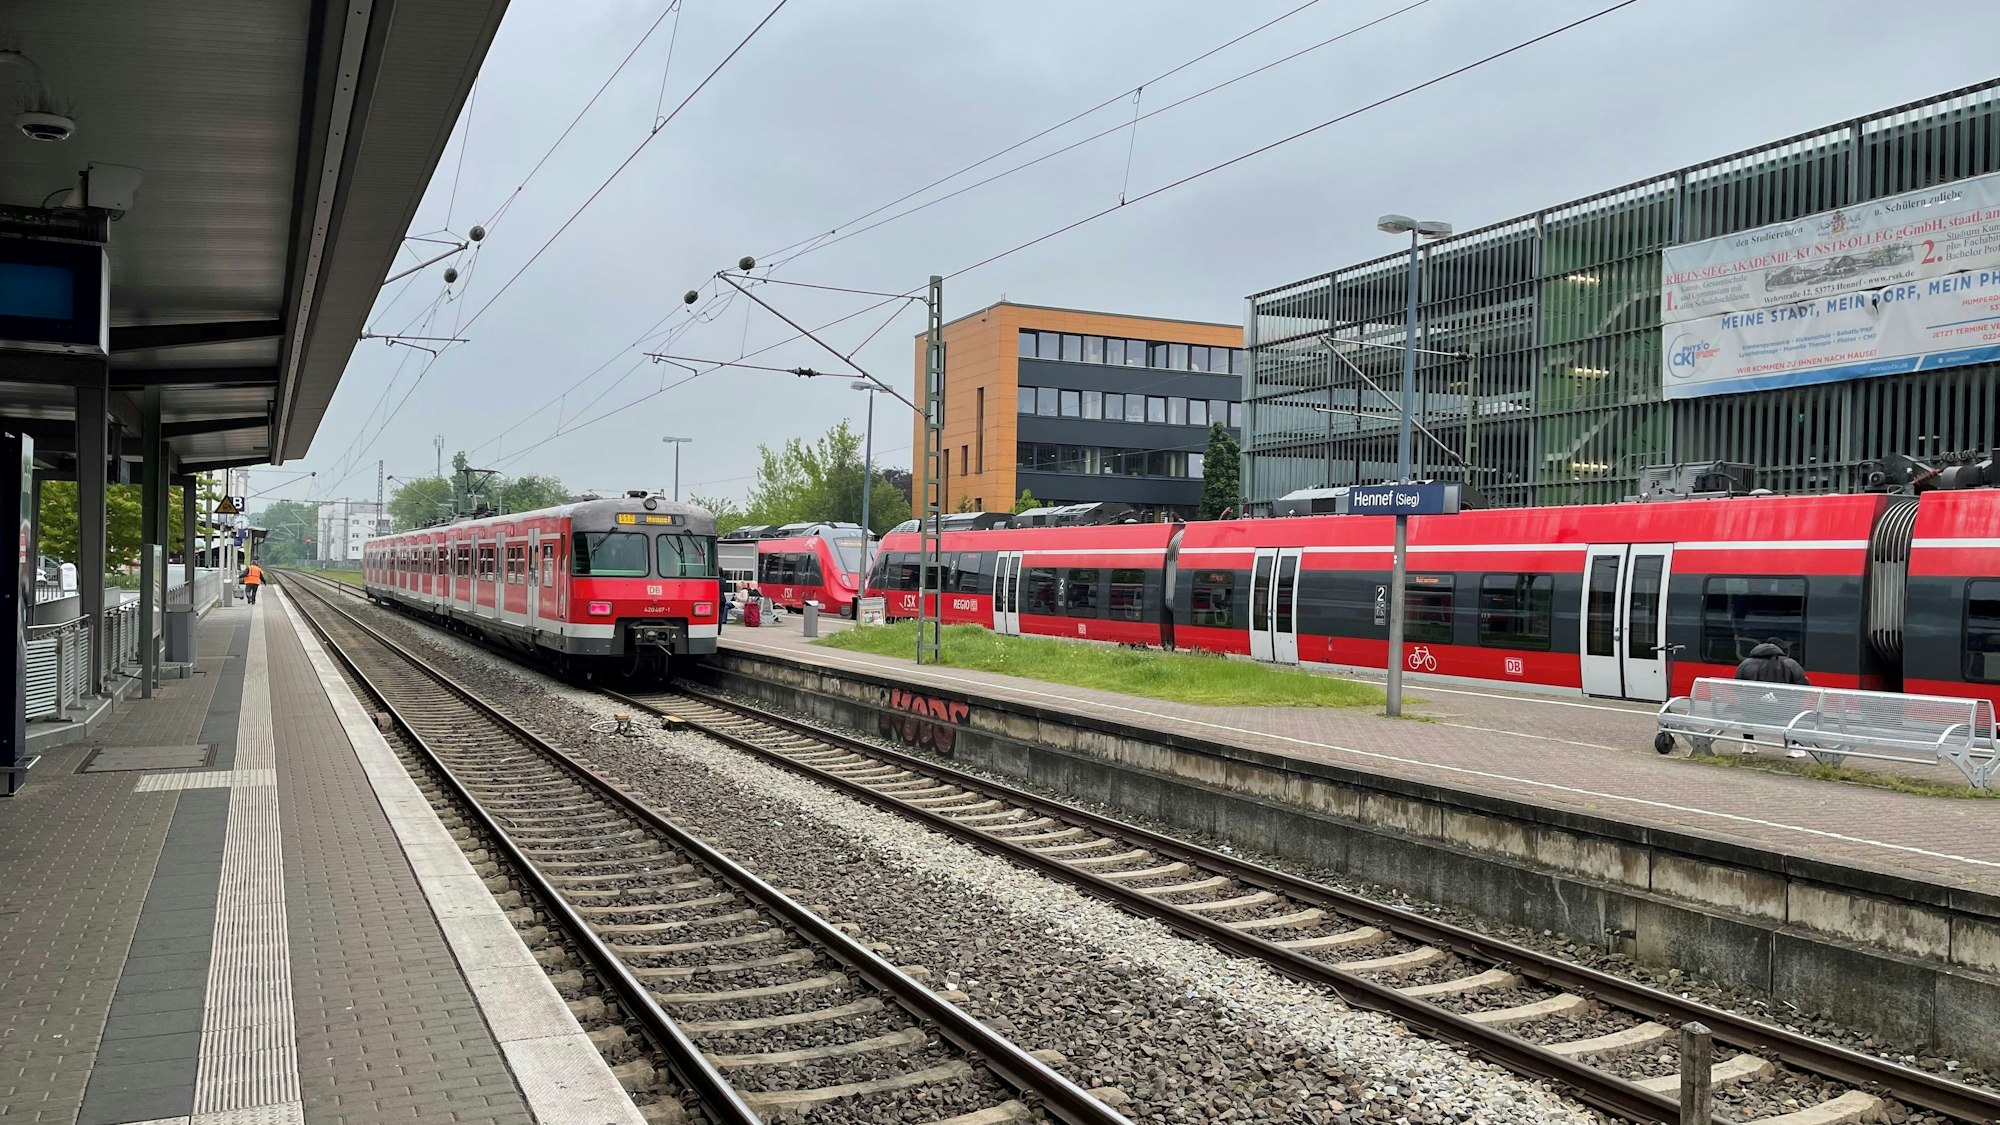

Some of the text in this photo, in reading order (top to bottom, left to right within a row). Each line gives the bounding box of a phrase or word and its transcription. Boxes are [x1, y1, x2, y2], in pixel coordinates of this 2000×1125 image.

[1885, 199, 1926, 214] Schülern
[1929, 190, 1963, 204] zuliebe
[1736, 238, 1749, 248] den
[1751, 226, 1803, 244] Studierenden
[1946, 227, 1980, 241] Studium
[1666, 229, 1893, 285] RHEIN-SIEG-AKADEMIE-KUNSTKOLLEG
[1949, 210, 1982, 227] staatl.
[1921, 239, 1943, 264] 2.
[1946, 242, 1961, 252] plus
[1946, 247, 1982, 261] Bachelor
[1703, 274, 1748, 288] Gesamtschule
[1764, 290, 1801, 304] Wehrstraße
[1815, 285, 1835, 296] 53773
[1837, 279, 1862, 291] Hennef
[1868, 269, 1915, 284] www.rsak.de
[1692, 286, 1730, 301] Gymnasium
[1731, 284, 1742, 294] mit
[1695, 292, 1750, 309] Schulabschlüssen
[1665, 290, 1678, 312] 1.
[1721, 312, 1764, 330] MEINE
[1771, 303, 1820, 323] STADT,
[1827, 295, 1865, 314] MEIN
[1929, 275, 1971, 295] MEIN
[1932, 330, 1954, 339] JETZT
[1956, 325, 1989, 335] TERMINE
[1737, 366, 1751, 374] WIR
[1752, 362, 1785, 372] KOMMEN
[1798, 358, 1823, 367] IHNEN
[1824, 354, 1845, 363] NACH
[1847, 349, 1877, 359] HAUSE!
[233, 497, 243, 509] B
[1354, 490, 1420, 508] Hennef (Sieg)
[649, 586, 661, 594] DB
[1059, 578, 1065, 590] 2
[1377, 587, 1385, 602] 2
[953, 599, 970, 610] REGIO
[1507, 660, 1521, 673] DB
